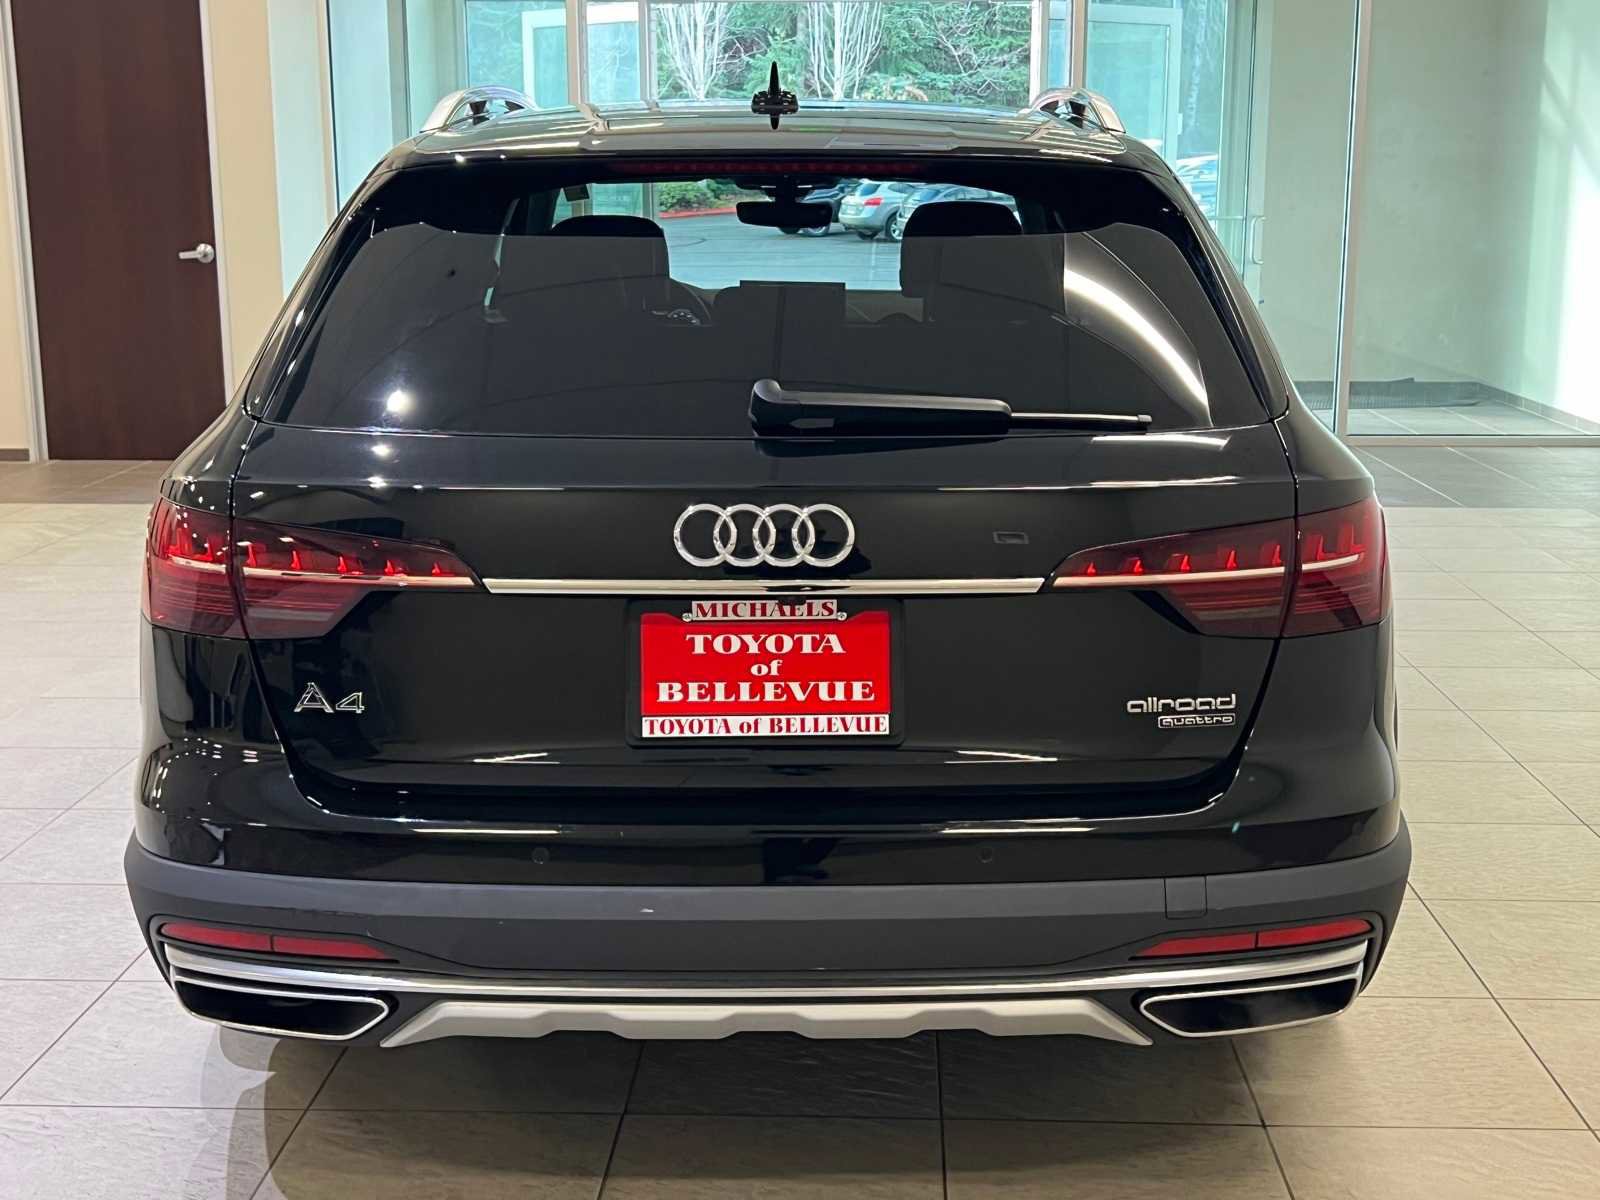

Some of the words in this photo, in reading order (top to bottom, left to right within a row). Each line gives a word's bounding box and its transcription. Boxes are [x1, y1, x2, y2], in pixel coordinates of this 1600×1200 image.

[695, 601, 836, 618] MICHAELS
[685, 633, 847, 655] TOYOTA
[750, 659, 783, 676] of
[293, 681, 365, 714] A4
[656, 680, 875, 703] BELLEVUE
[1127, 693, 1236, 713] allroad
[644, 717, 731, 736] TOYOTA
[739, 717, 763, 735] of
[768, 715, 887, 734] BELLEVUE
[1161, 716, 1233, 727] quattro
